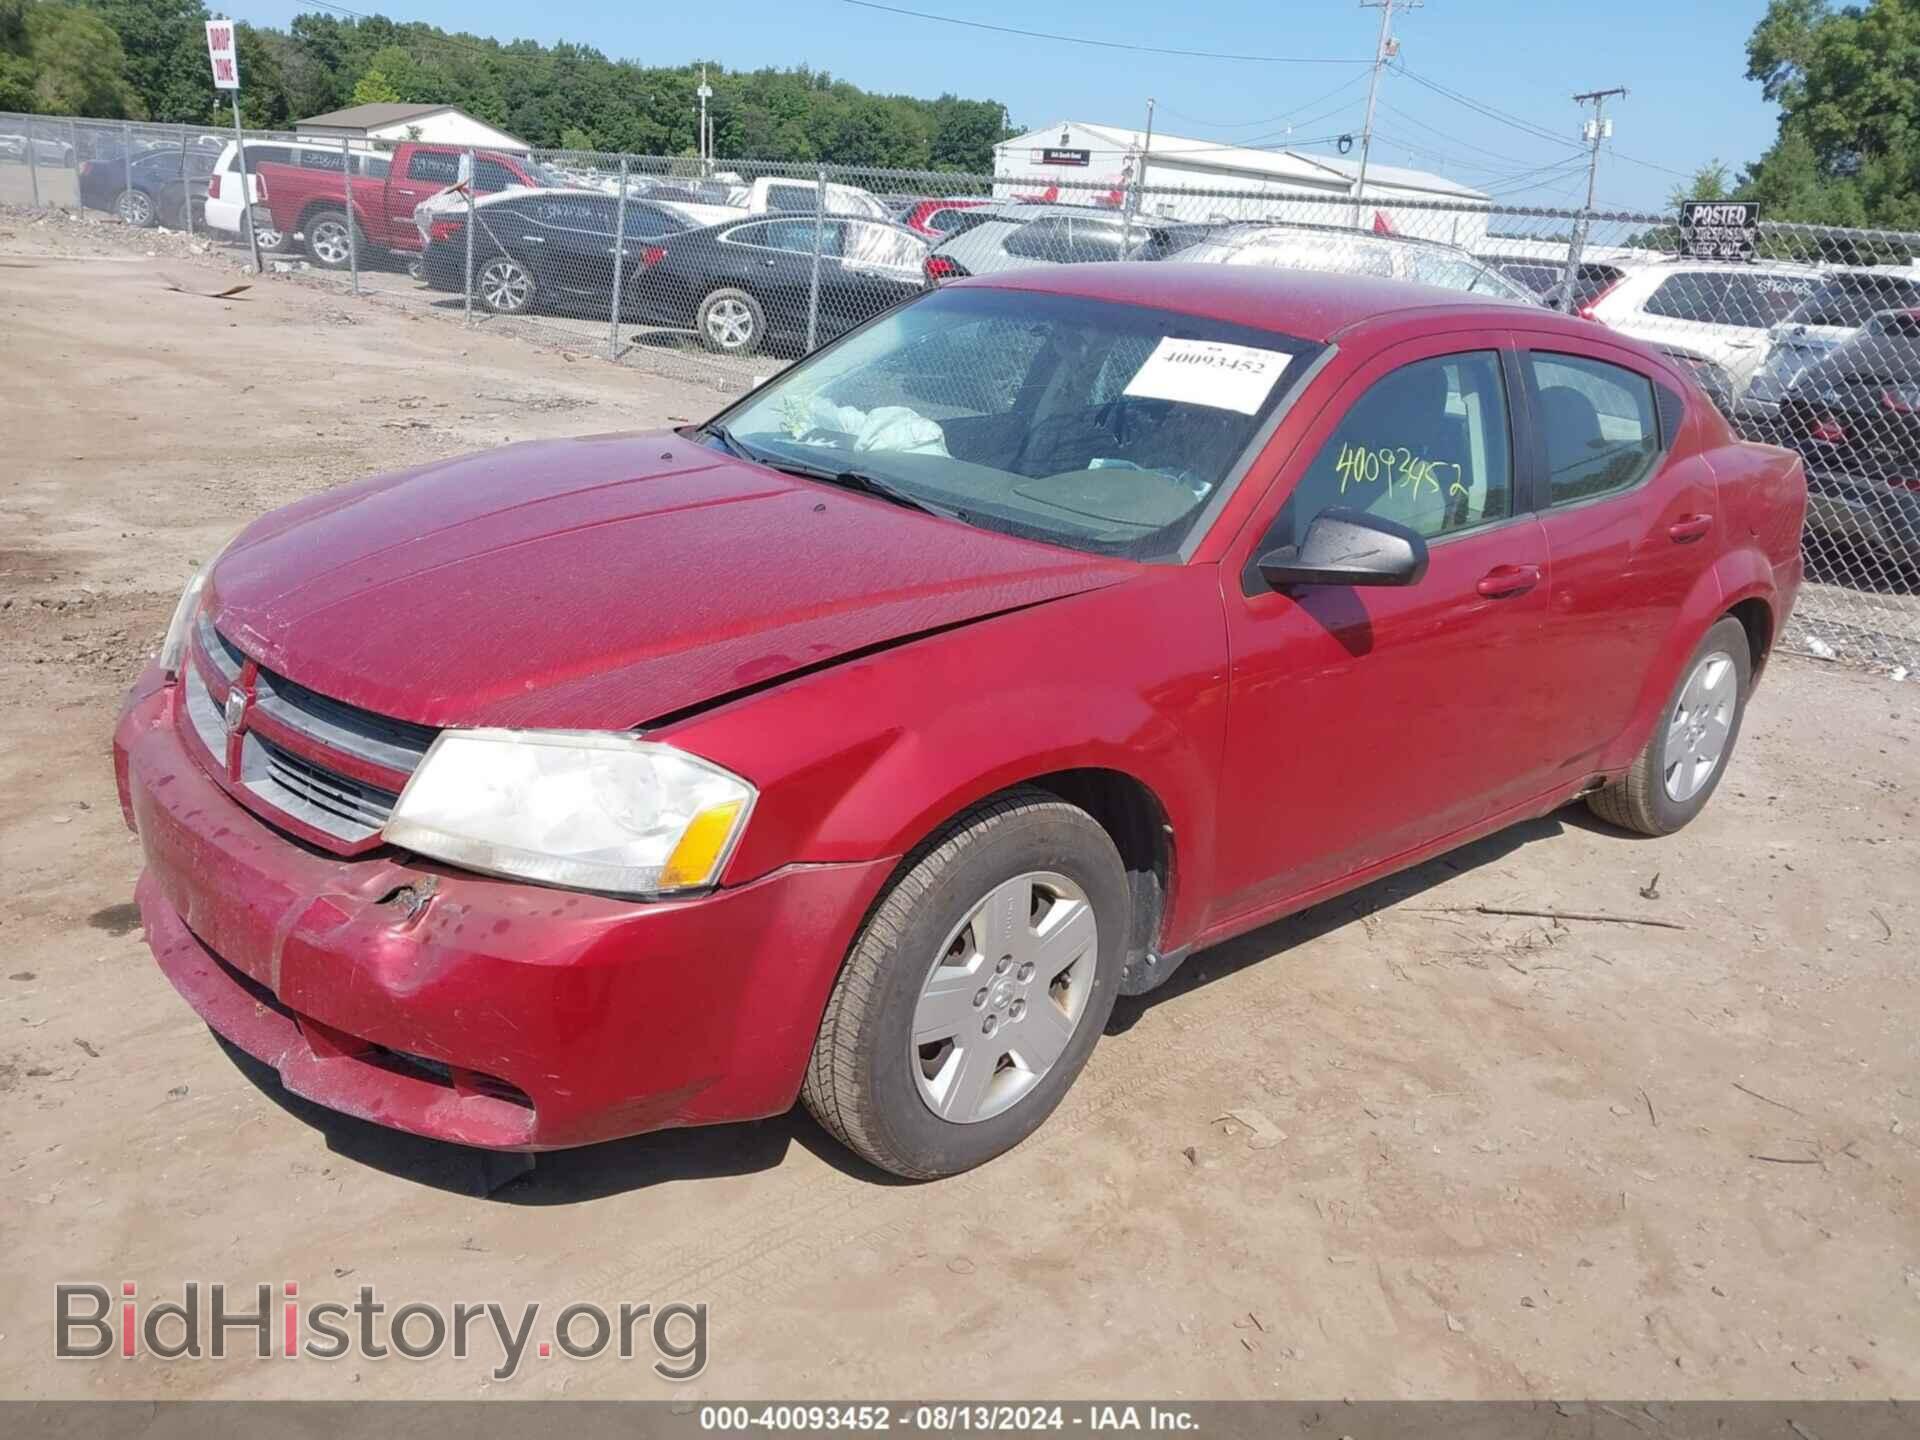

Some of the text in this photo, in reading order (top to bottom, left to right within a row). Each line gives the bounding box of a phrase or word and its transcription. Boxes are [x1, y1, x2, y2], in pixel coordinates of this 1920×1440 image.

[210, 28, 230, 51] DROP
[216, 59, 234, 81] ZONE
[1693, 205, 1747, 225] POSTED
[1720, 242, 1742, 256] OUT
[1163, 352, 1265, 374] 40093452
[1336, 441, 1470, 502] 40093452
